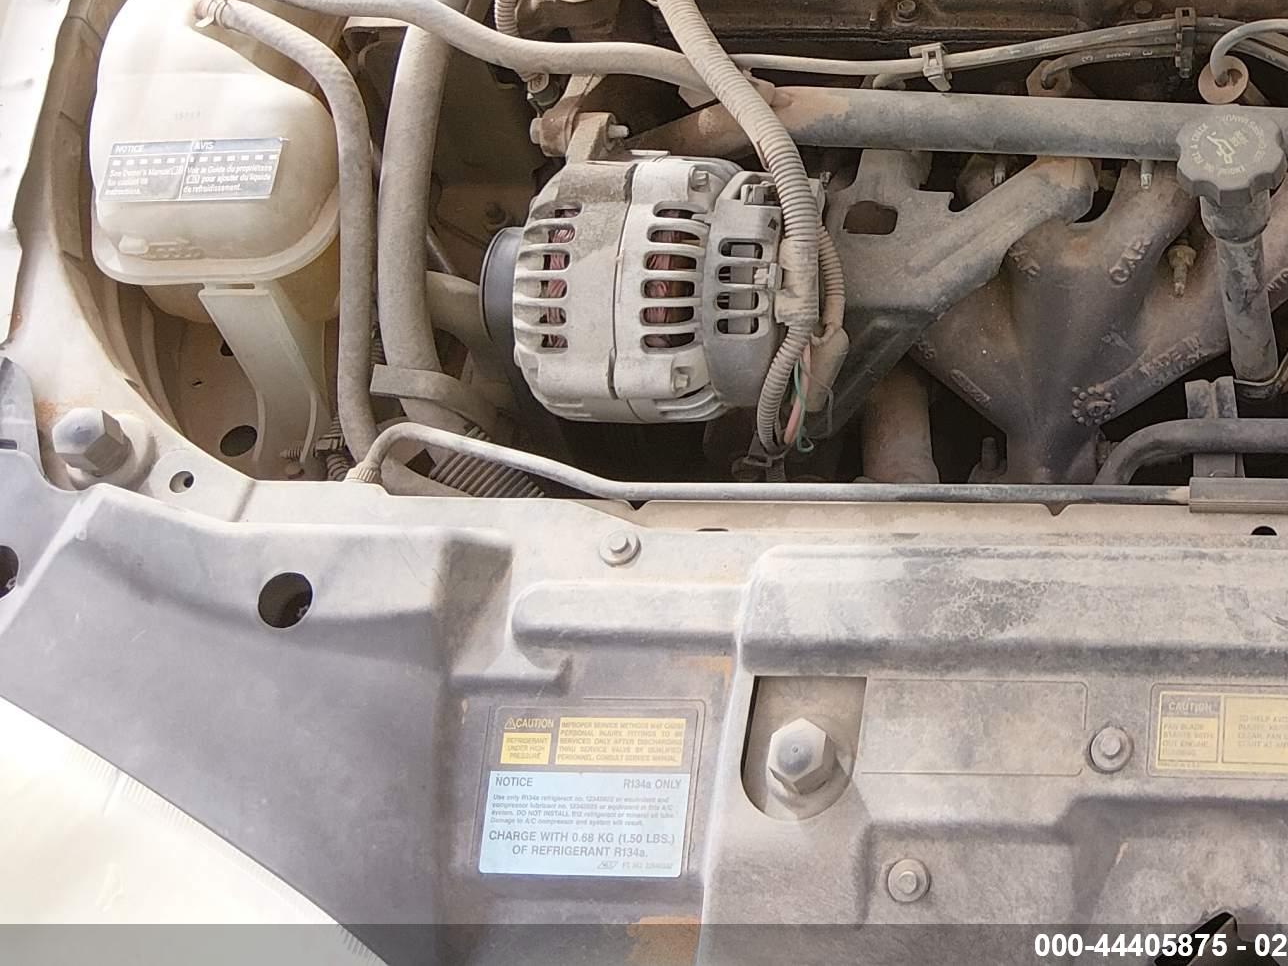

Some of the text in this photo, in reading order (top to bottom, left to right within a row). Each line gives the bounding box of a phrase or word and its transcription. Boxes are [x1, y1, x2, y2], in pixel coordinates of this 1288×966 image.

[115, 144, 145, 153] NOTICE
[194, 141, 214, 150] AVIS
[1168, 701, 1212, 713] CAUTION
[515, 718, 554, 729] CAUTION
[495, 777, 533, 787] NOTICE
[623, 779, 682, 789] R134a ONLY
[507, 795, 520, 803] only
[541, 795, 573, 804] refrigerant
[543, 810, 569, 818] INSTALL
[490, 818, 516, 826] Damage
[538, 819, 575, 827] compressor
[488, 831, 675, 845] CHARGE WITH 0.68 KG (1.50 LBS.)
[512, 845, 648, 858] OF REFRIGERANT R134a.
